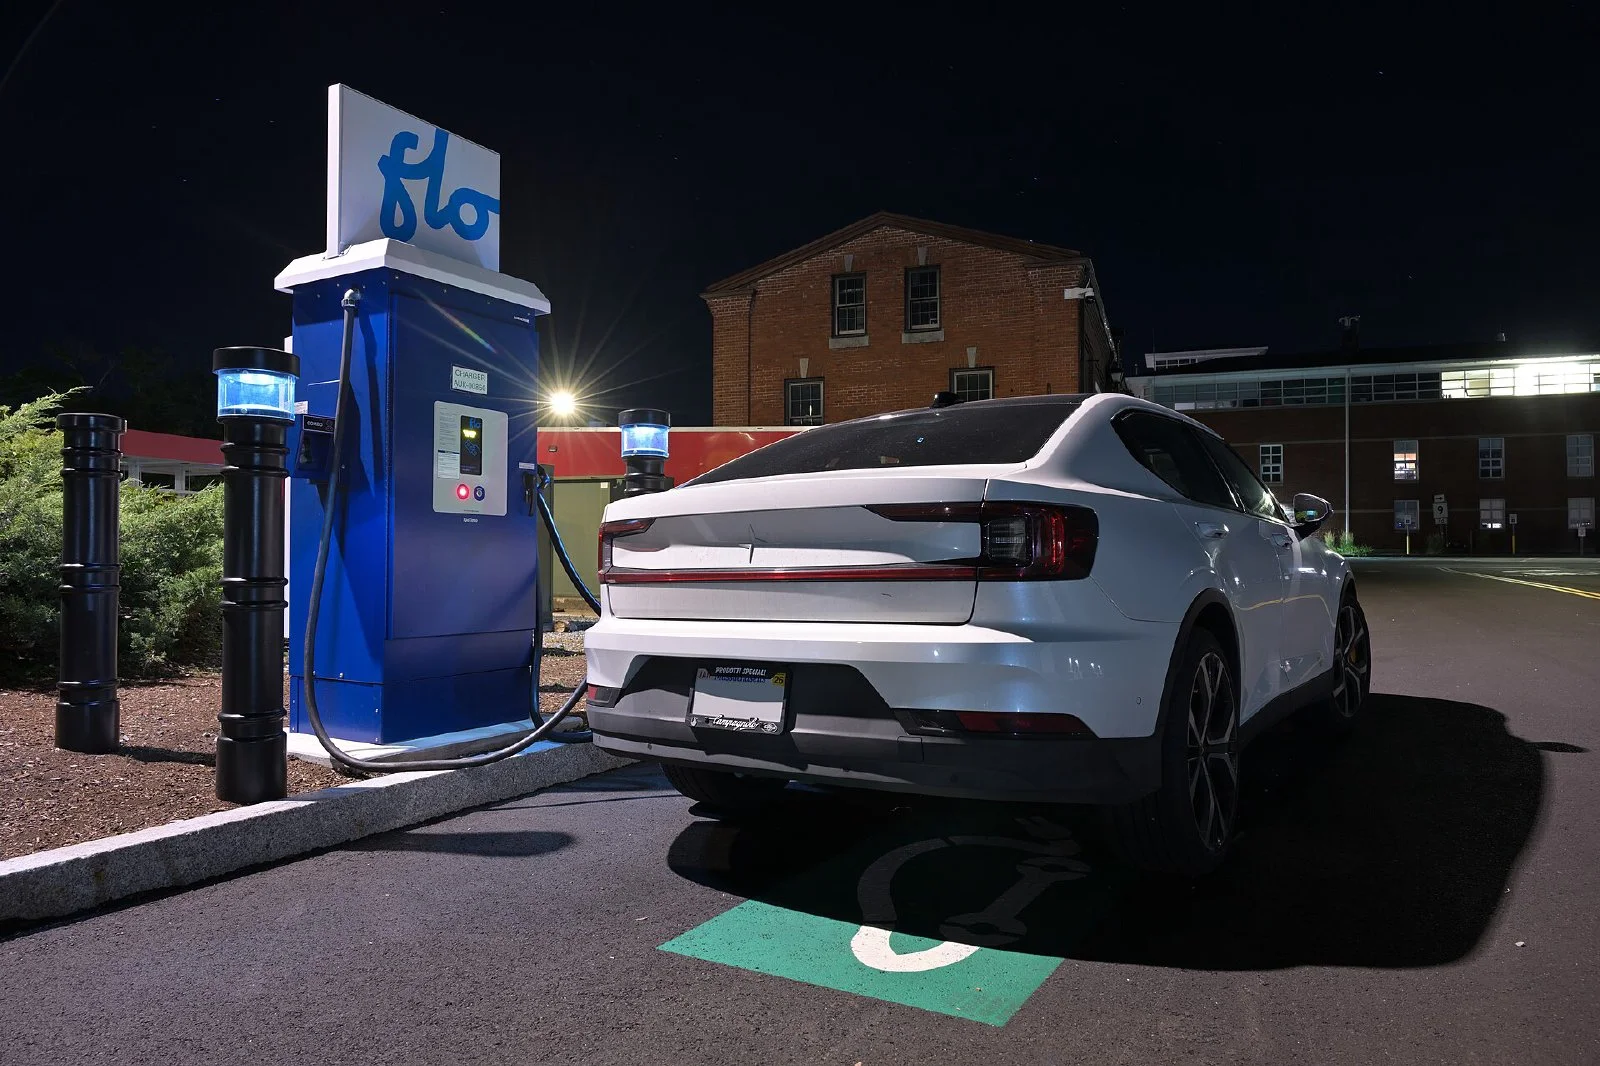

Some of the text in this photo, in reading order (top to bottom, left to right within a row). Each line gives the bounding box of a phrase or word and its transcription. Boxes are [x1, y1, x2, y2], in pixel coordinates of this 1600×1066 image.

[378, 127, 500, 242] flo
[455, 369, 486, 381] CHARGER
[1437, 505, 1444, 514] 9
[708, 714, 759, 731] Campagnolo
